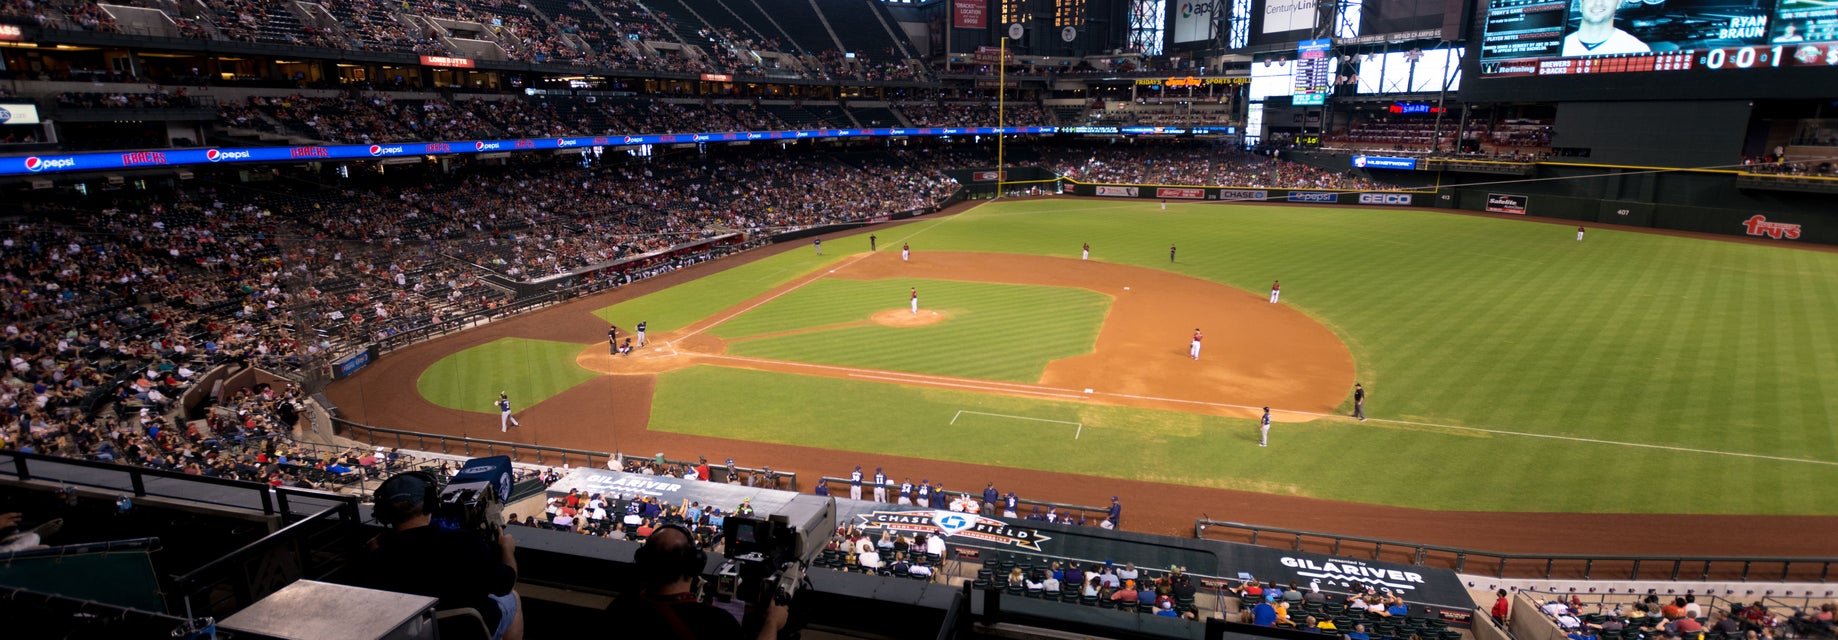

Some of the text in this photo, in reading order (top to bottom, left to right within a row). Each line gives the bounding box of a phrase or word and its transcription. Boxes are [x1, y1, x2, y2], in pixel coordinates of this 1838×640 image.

[1730, 15, 1767, 28] RYAN
[1719, 27, 1764, 39] BRAUN
[1707, 48, 1725, 69] 0
[1736, 46, 1756, 68] 0
[1771, 45, 1783, 67] 1
[1539, 67, 1567, 75] D-BACKS
[1683, 62, 1690, 70] 2
[1541, 60, 1571, 68] BREWERS
[1499, 66, 1535, 74] Refining
[222, 150, 250, 160] pepsi
[382, 146, 402, 155] pepsi
[44, 157, 74, 169] pepsi
[1304, 193, 1331, 201] pepsi
[1360, 193, 1411, 204] GEICO
[1489, 198, 1517, 206] Safelite
[876, 477, 884, 485] 11
[878, 515, 1029, 539] CHASE FIELD
